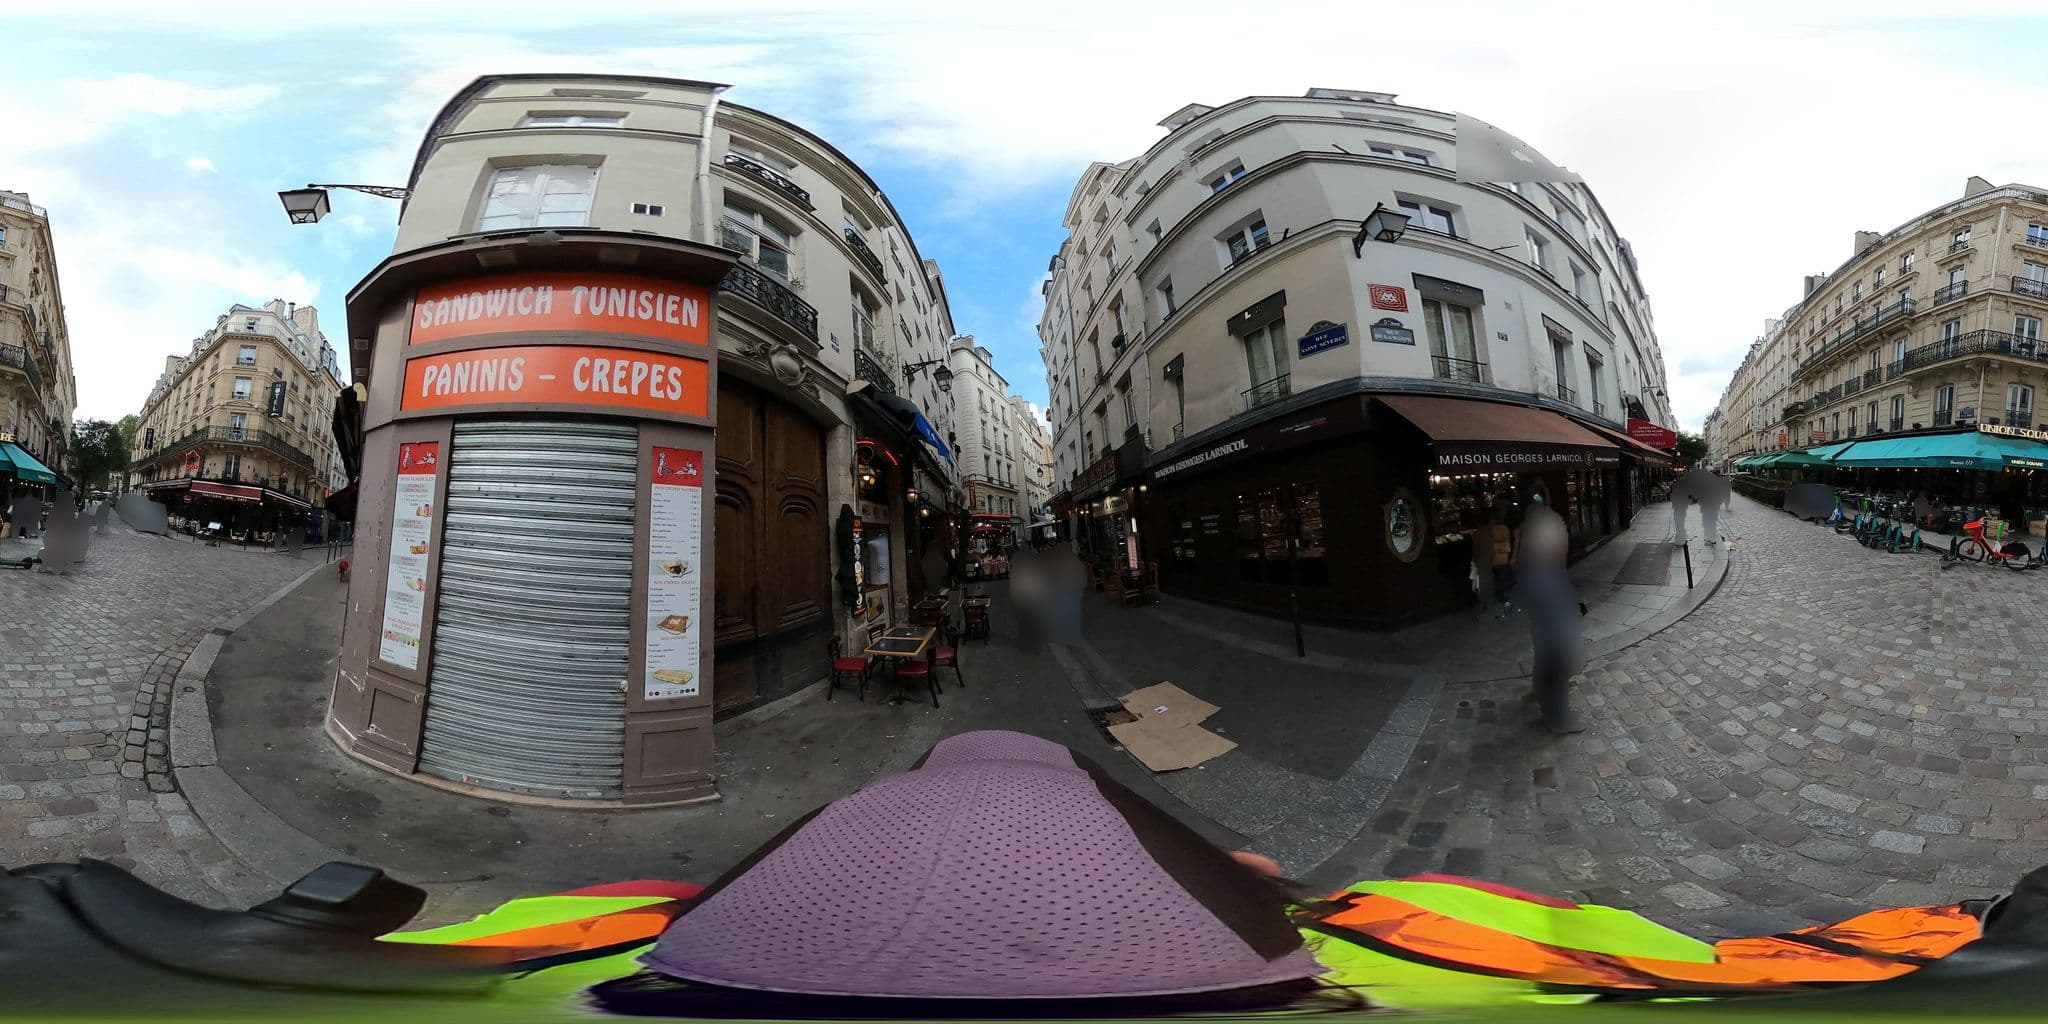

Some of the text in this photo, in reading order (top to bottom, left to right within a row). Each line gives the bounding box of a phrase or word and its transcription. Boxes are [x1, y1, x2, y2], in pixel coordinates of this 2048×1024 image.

[419, 285, 699, 329] SANDWICH TUNISIEN
[422, 356, 525, 397] PANINIS
[572, 356, 682, 401] CREPES
[1980, 424, 2015, 435] UNION
[1204, 438, 1249, 462] LARNICOL
[1439, 453, 1584, 466] MAISON GEORGES LARNICOL
